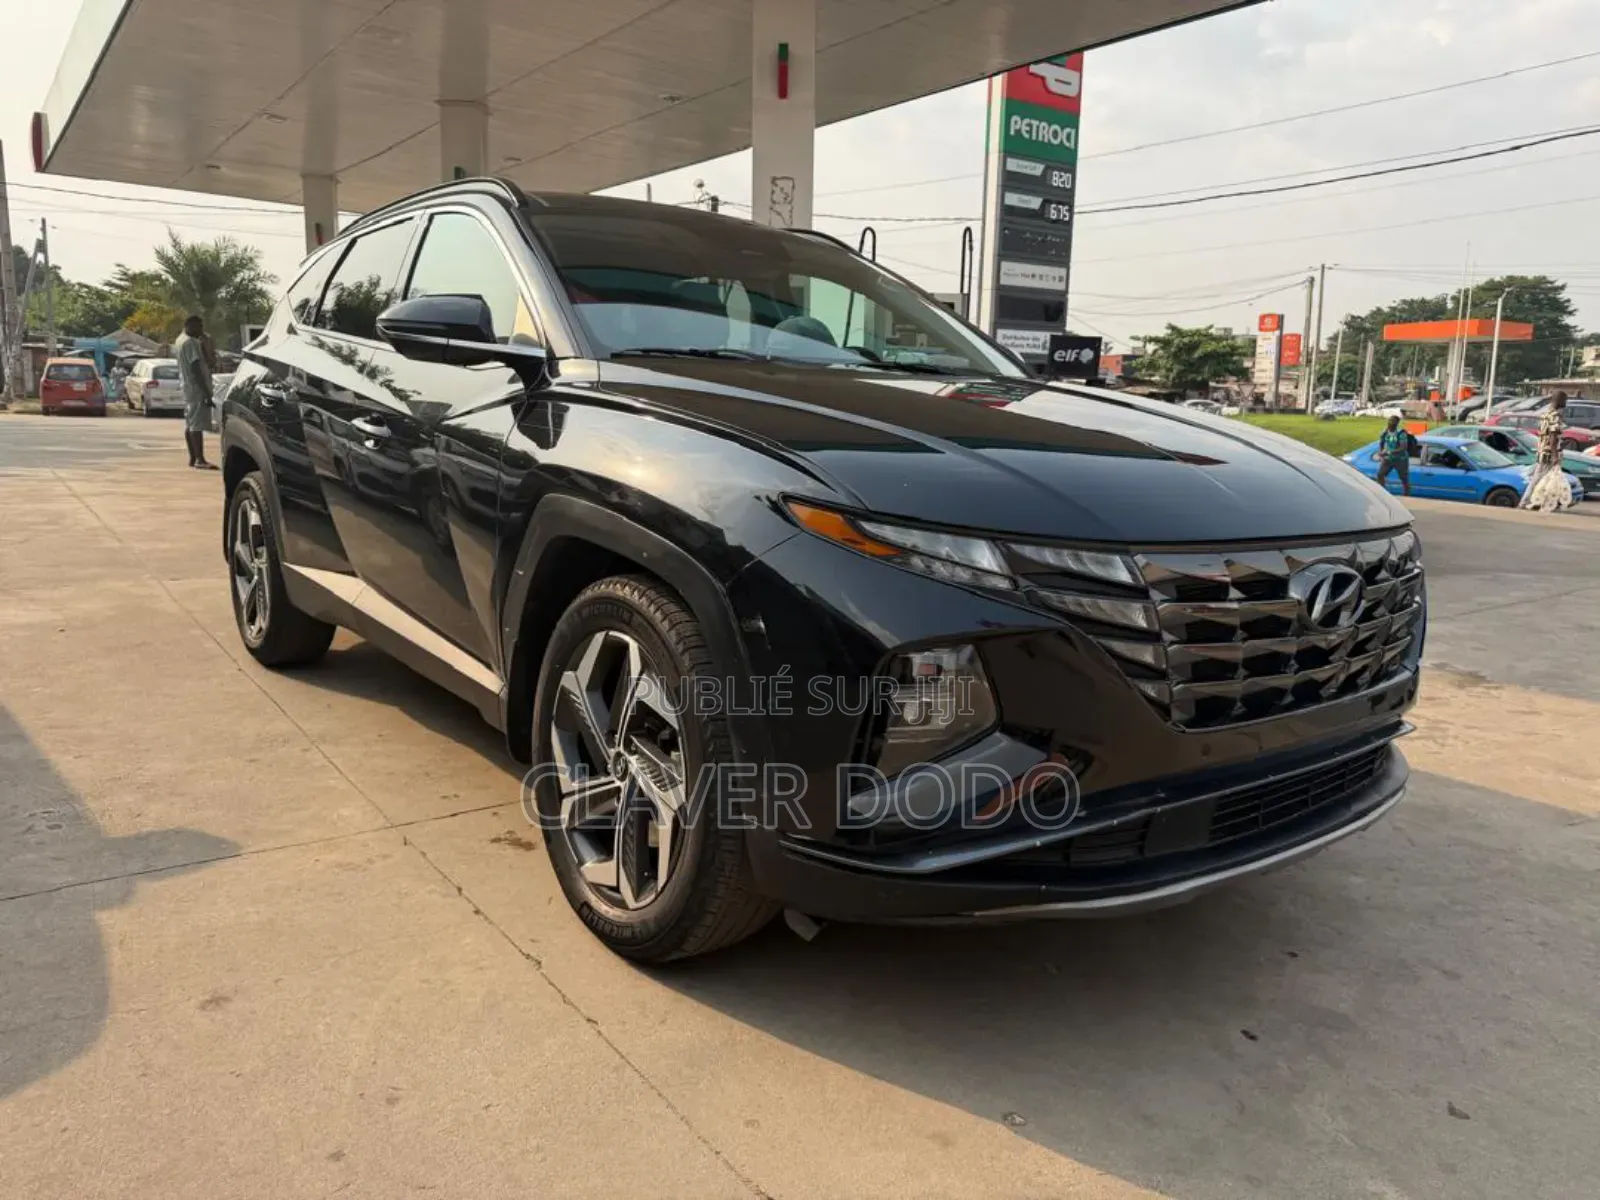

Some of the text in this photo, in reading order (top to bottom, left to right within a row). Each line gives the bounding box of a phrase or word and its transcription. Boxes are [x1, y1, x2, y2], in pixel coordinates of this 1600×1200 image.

[1009, 115, 1076, 149] PETROCI
[1051, 170, 1072, 189] 820
[1049, 203, 1070, 221] 675
[1053, 347, 1080, 363] elf
